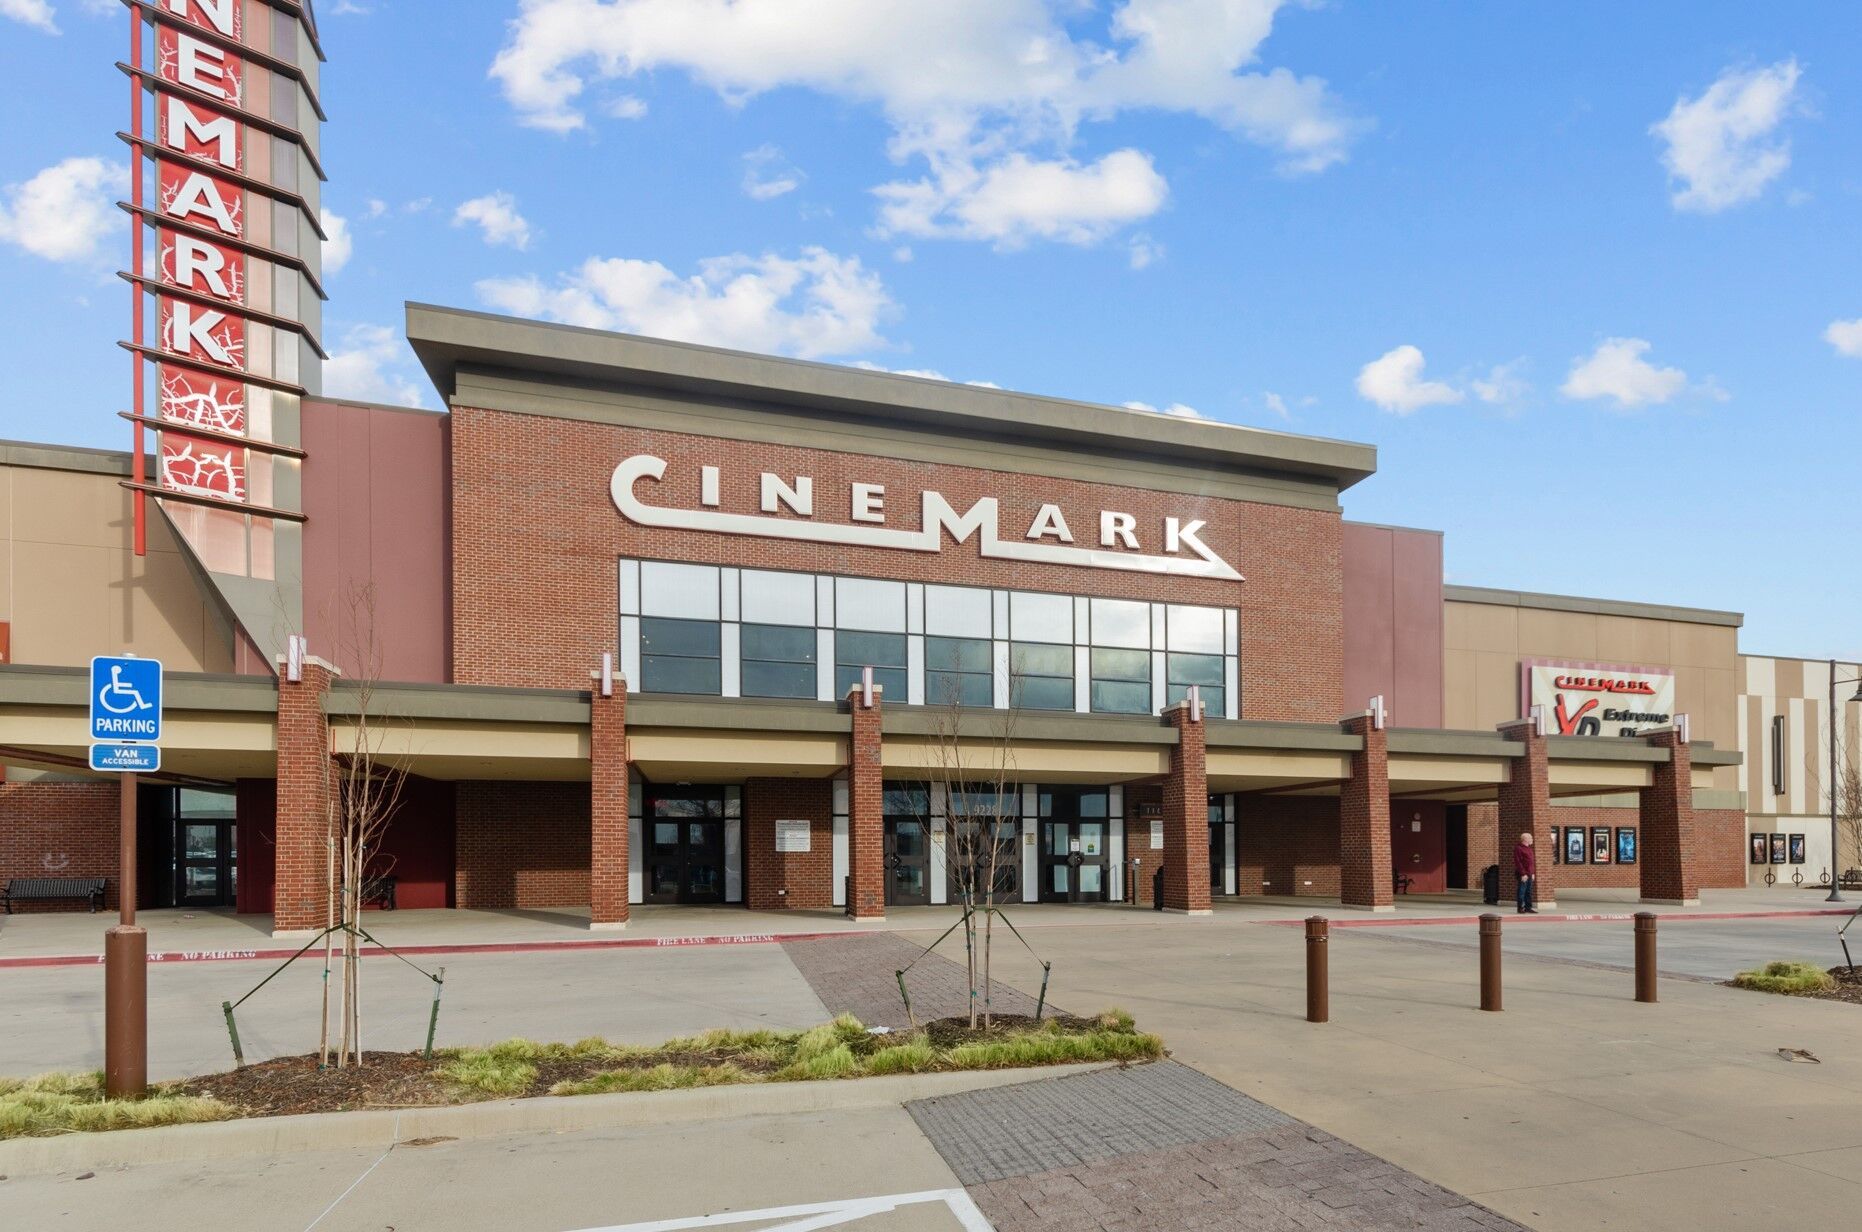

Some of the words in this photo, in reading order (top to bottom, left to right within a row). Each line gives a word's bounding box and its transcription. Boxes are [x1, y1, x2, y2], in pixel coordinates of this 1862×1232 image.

[610, 455, 1245, 582] CINEMARK
[1554, 675, 1656, 695] CINEMARK
[1603, 708, 1669, 724] Extreme
[96, 718, 156, 734] PARKING
[114, 748, 138, 758] VAN
[102, 757, 149, 766] ACCESSIBLE
[180, 952, 199, 961] NO
[201, 950, 257, 960] PARKING
